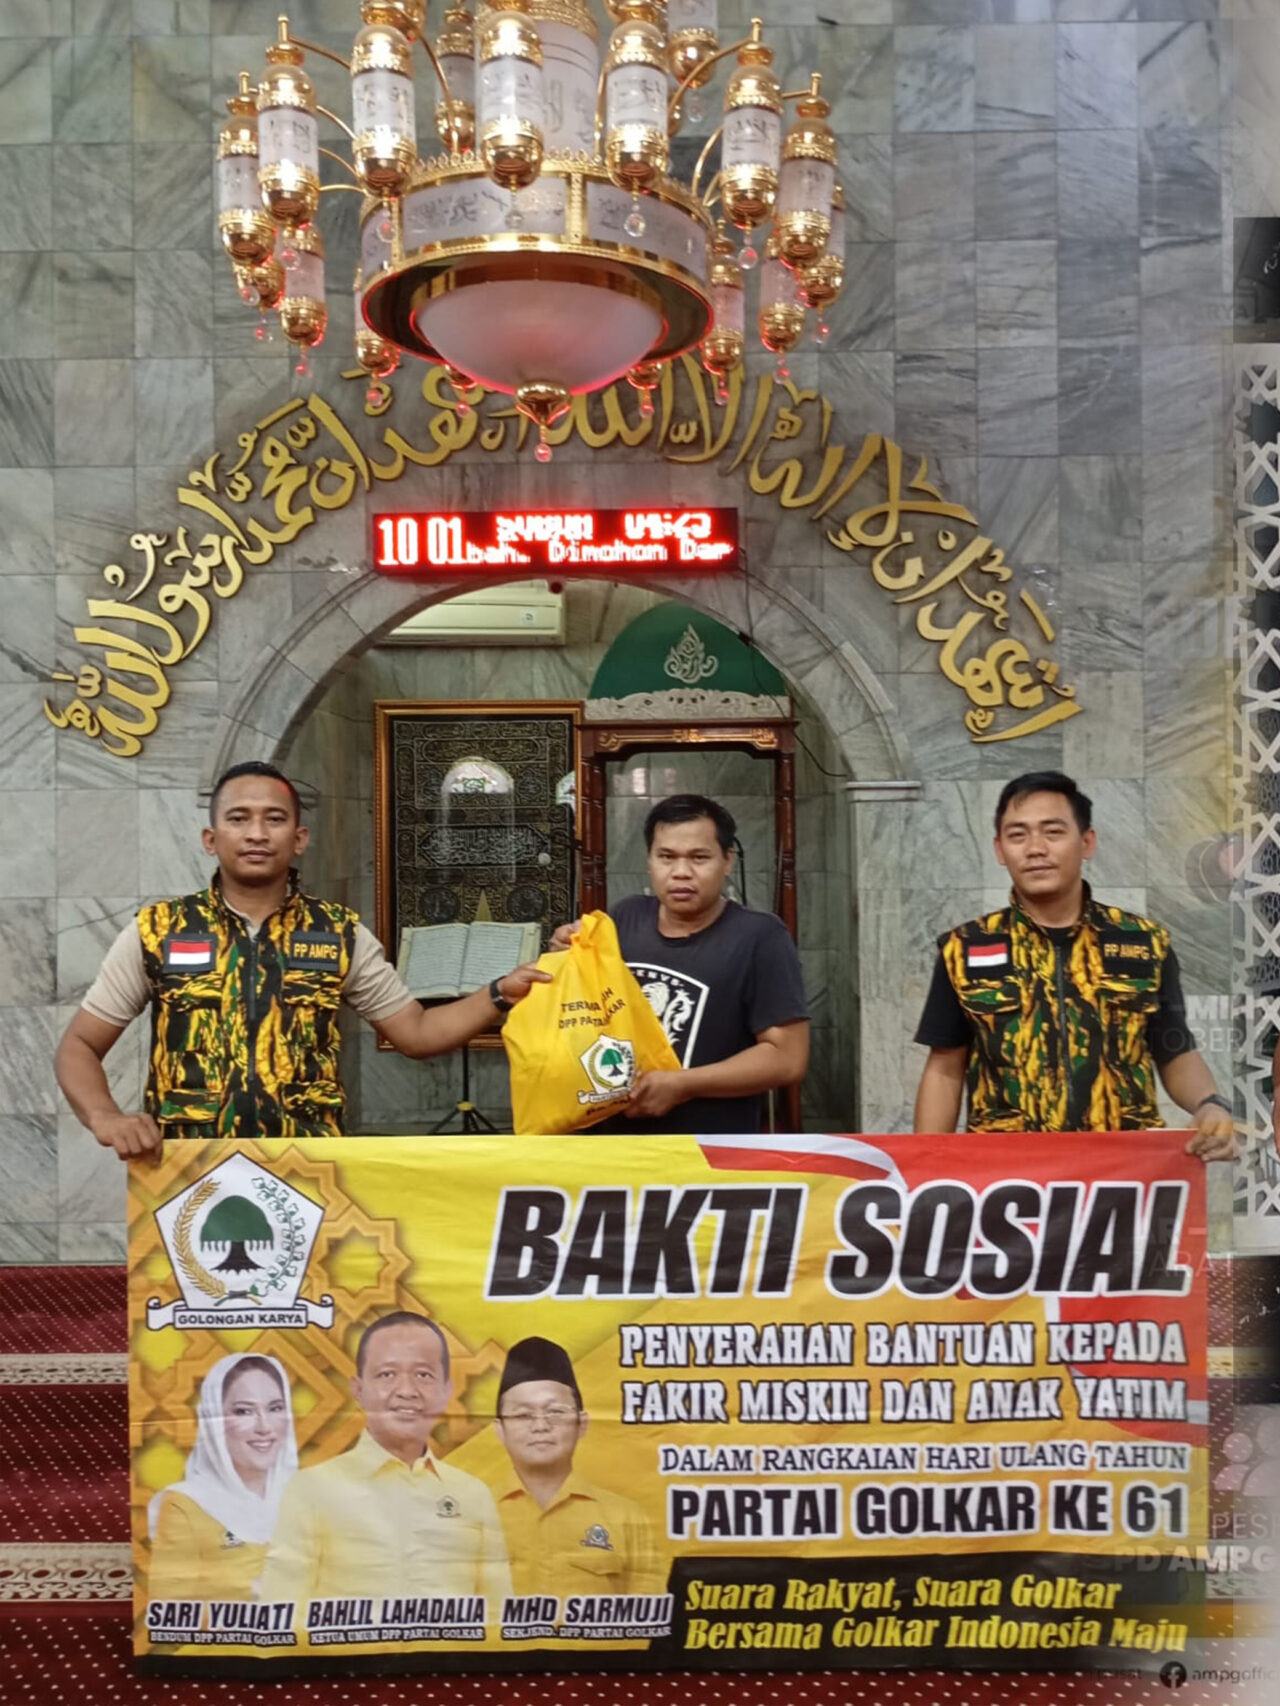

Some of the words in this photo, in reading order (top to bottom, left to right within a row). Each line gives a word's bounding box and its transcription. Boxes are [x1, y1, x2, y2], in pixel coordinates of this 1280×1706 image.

[379, 517, 419, 566] 10
[427, 516, 466, 565] 01
[293, 943, 308, 958] PP
[309, 943, 338, 960] AMPG
[1104, 943, 1119, 957] PP
[485, 1185, 806, 1299] BAKTI
[828, 1182, 1189, 1297] SOSIAL
[177, 1314, 254, 1326] GOLONGAN
[258, 1313, 303, 1325] KARYA
[620, 1322, 855, 1367] PENYERAHAN
[866, 1321, 1036, 1366] BANTUAN
[1047, 1320, 1188, 1365] KEPADA
[621, 1380, 729, 1424] FAKIR
[738, 1379, 870, 1424] MISKIN
[881, 1379, 954, 1423] DAN
[966, 1378, 1063, 1422] ANAK
[1073, 1376, 1187, 1421] YATIM
[661, 1447, 754, 1472] DALAM
[762, 1446, 917, 1471] RANGKAIAN
[925, 1445, 992, 1470] HARI
[1001, 1443, 1087, 1468] ULANG
[1096, 1445, 1188, 1470] TAHUN
[671, 1487, 838, 1537] PARTAI
[856, 1485, 1036, 1536] GOLKAR
[1054, 1485, 1109, 1533] KE
[1126, 1485, 1184, 1534] 61
[684, 1579, 777, 1611] Suara
[782, 1577, 901, 1613] Rakyat,
[912, 1576, 1002, 1608] Suara
[1010, 1573, 1123, 1610] Golkar
[148, 1601, 202, 1628] SARI
[208, 1602, 295, 1631] YULIATI
[307, 1599, 374, 1629] BAHLIL
[380, 1598, 485, 1626] LAHADALIA
[502, 1597, 558, 1624] MHD
[566, 1595, 673, 1624] SARMUJI
[150, 1630, 193, 1643] BENDUM
[194, 1631, 214, 1643] DPP
[215, 1632, 251, 1644] PARTAI
[253, 1633, 296, 1645] GOLKAR
[310, 1631, 346, 1644] KETUA
[347, 1630, 380, 1642] UMUM
[381, 1629, 401, 1641] DPP
[402, 1628, 440, 1641] PARTAI
[441, 1628, 484, 1640] GOLKAR
[559, 1627, 581, 1639] DPP
[582, 1627, 624, 1639] PARTAI
[625, 1626, 672, 1638] GOLKAR
[683, 1617, 824, 1650] Bersama
[831, 1616, 941, 1648] Golkar
[945, 1614, 1102, 1650] Indonesia
[1108, 1617, 1189, 1654] Maju
